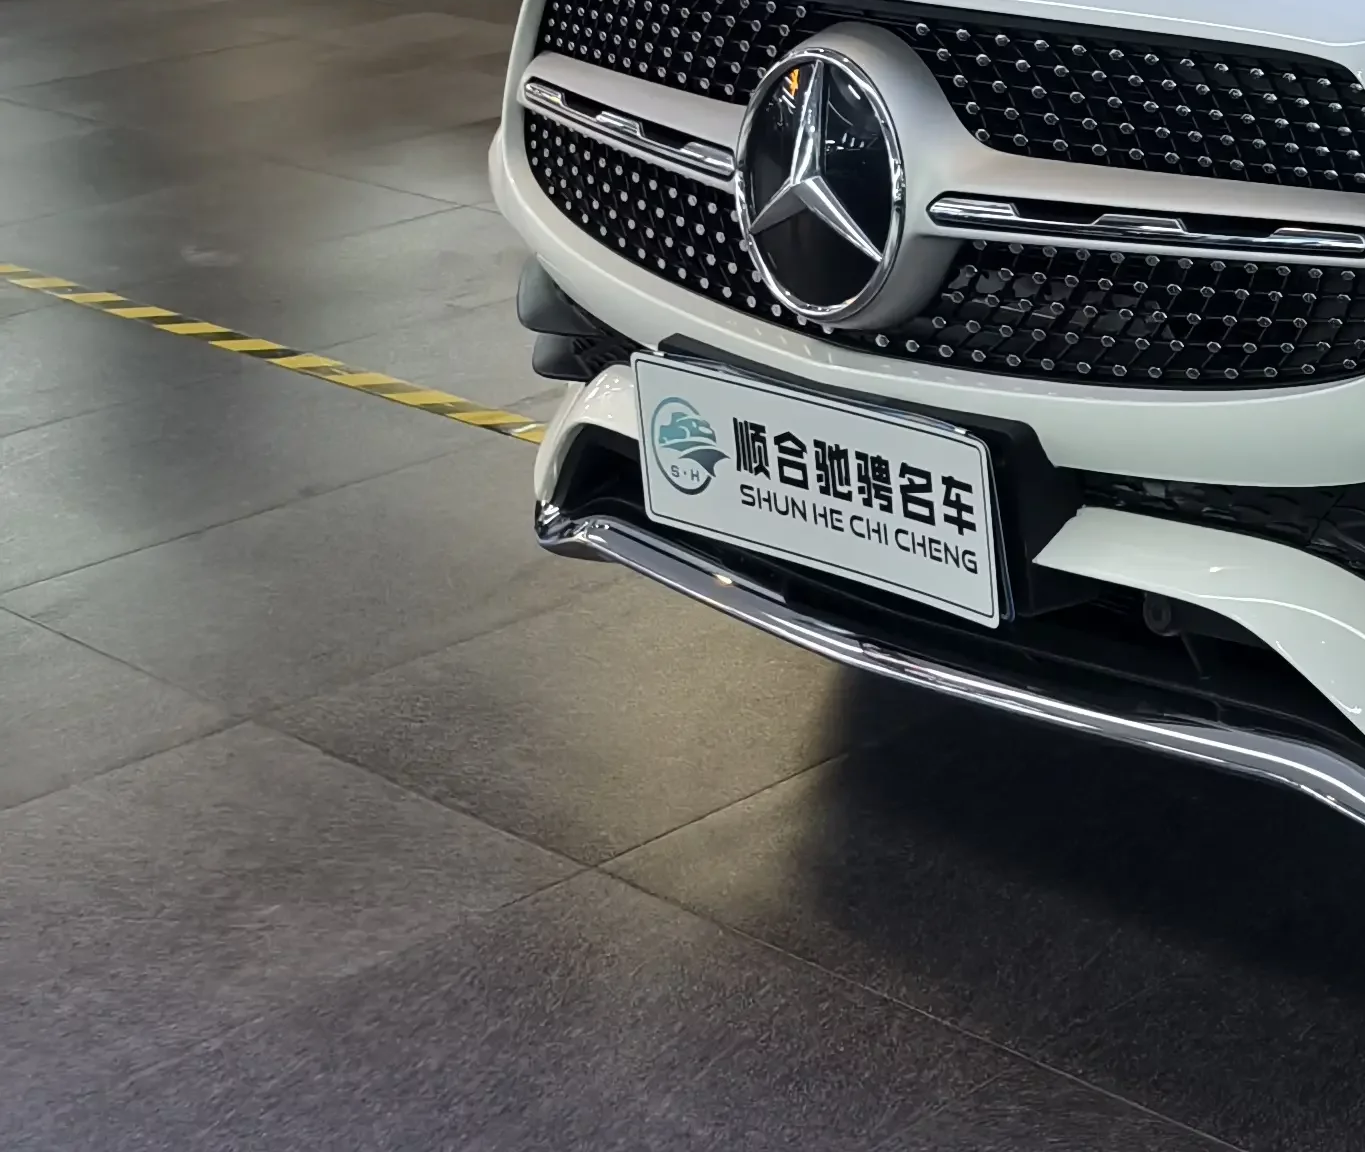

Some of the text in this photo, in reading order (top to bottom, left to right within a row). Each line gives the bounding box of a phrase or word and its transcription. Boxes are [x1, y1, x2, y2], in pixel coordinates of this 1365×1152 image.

[732, 416, 978, 536] 顺合驰骋名车
[739, 483, 979, 574] SHUN HE CHI CHENG
